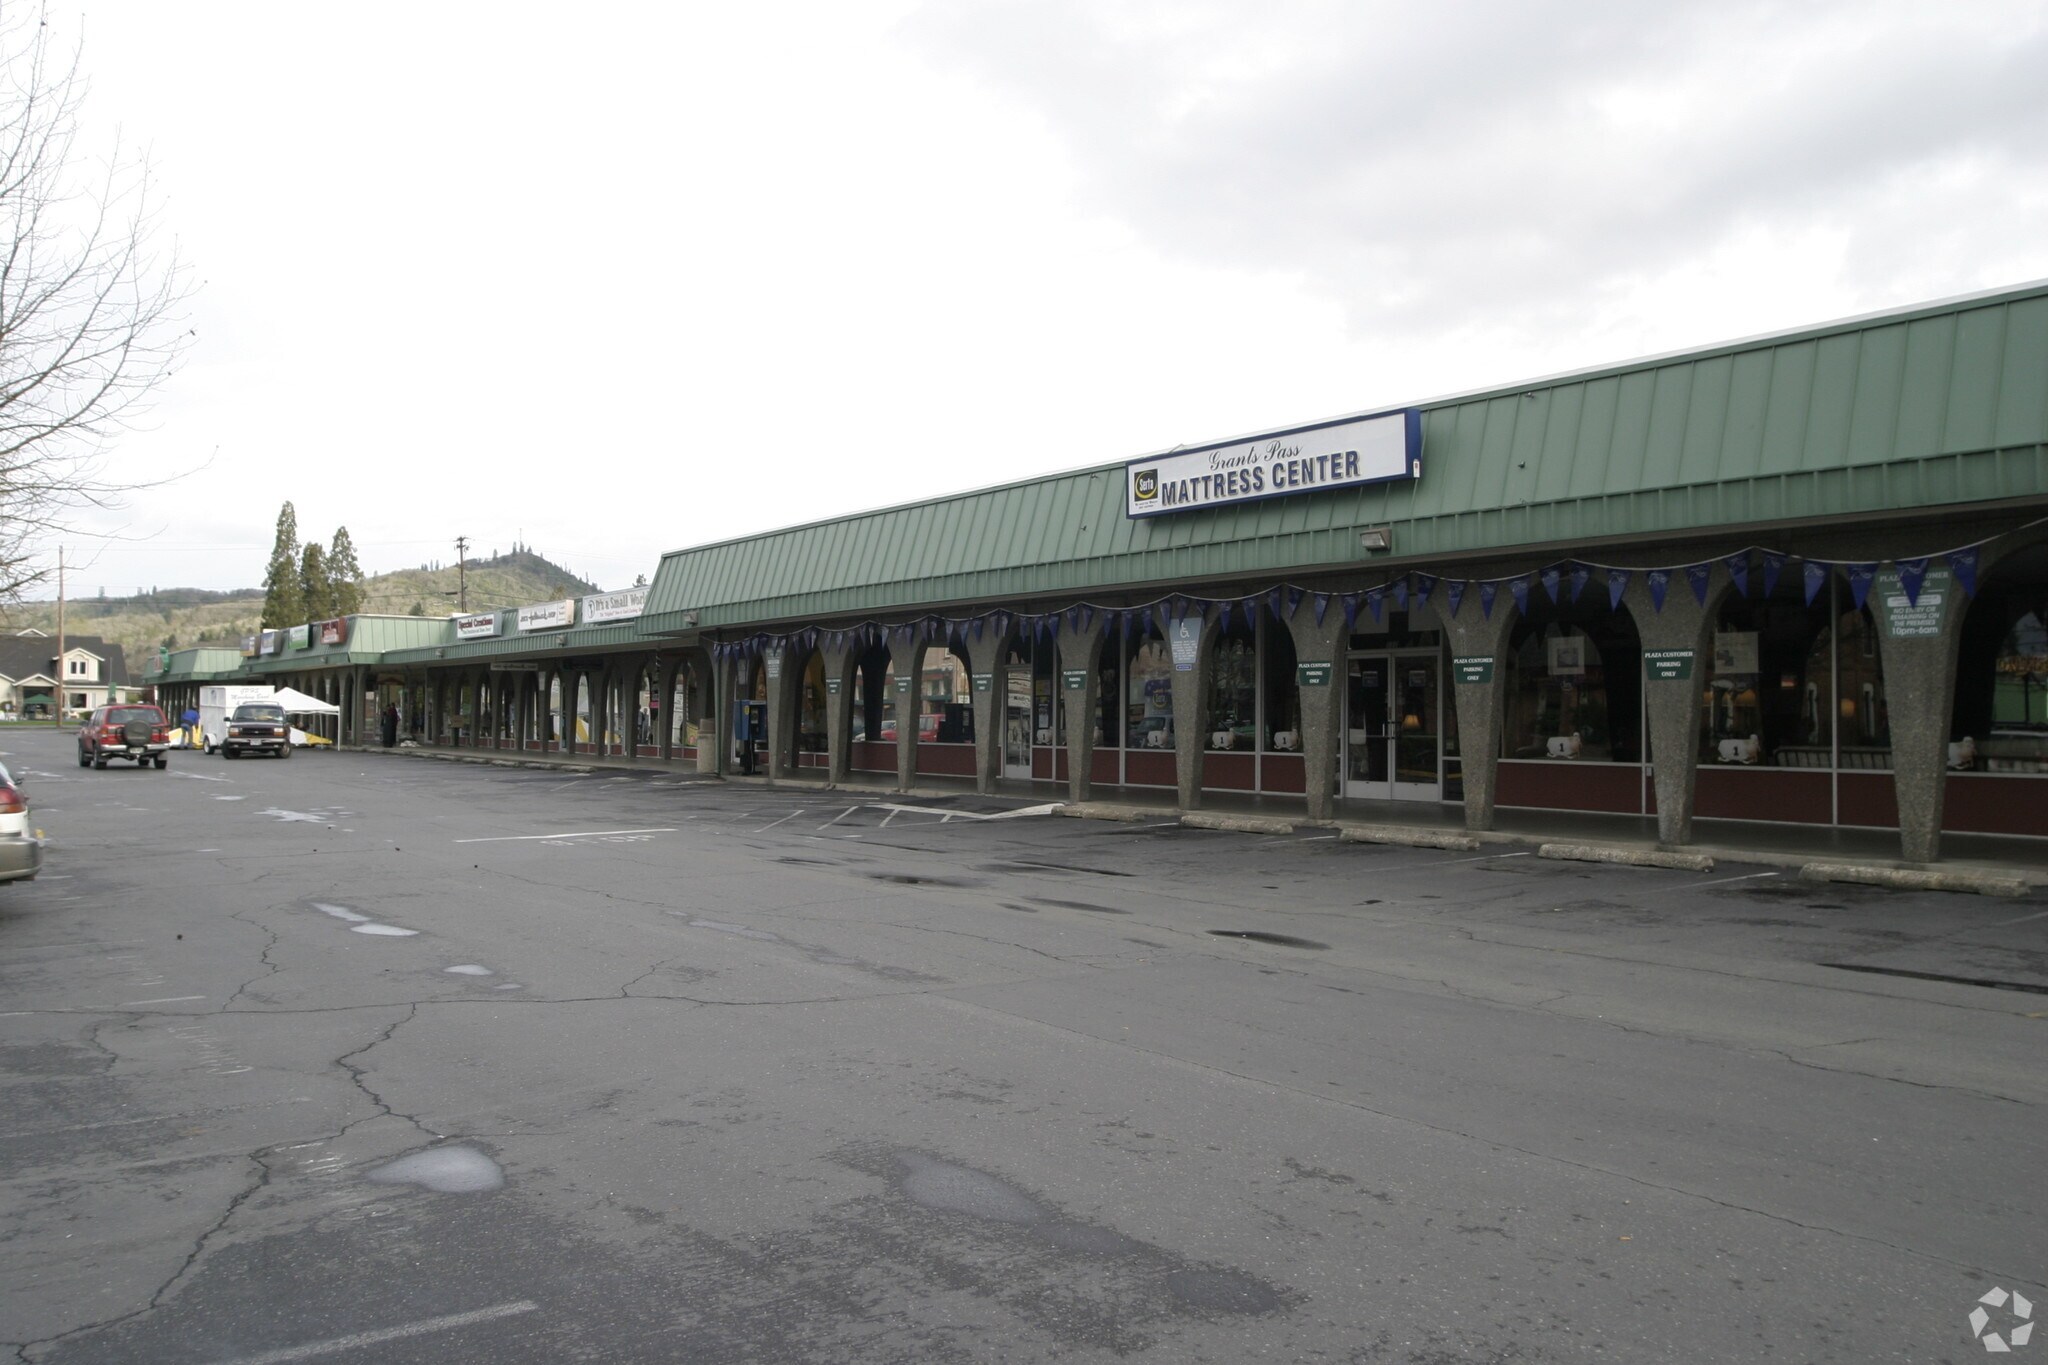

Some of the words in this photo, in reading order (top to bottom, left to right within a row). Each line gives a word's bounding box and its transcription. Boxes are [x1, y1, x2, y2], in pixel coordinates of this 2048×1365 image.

[1208, 446, 1261, 471] Grants
[1263, 440, 1303, 462] Pass
[1161, 465, 1265, 507] MATTRESS
[1272, 450, 1361, 489] CENTER
[1139, 478, 1154, 492] Serta
[610, 594, 628, 609] Small
[1890, 613, 1927, 621] REMAINING
[1892, 626, 1938, 636] 10pm-6am
[1282, 736, 1287, 745] 1
[1559, 742, 1565, 752] 1
[1733, 746, 1739, 756] 1
